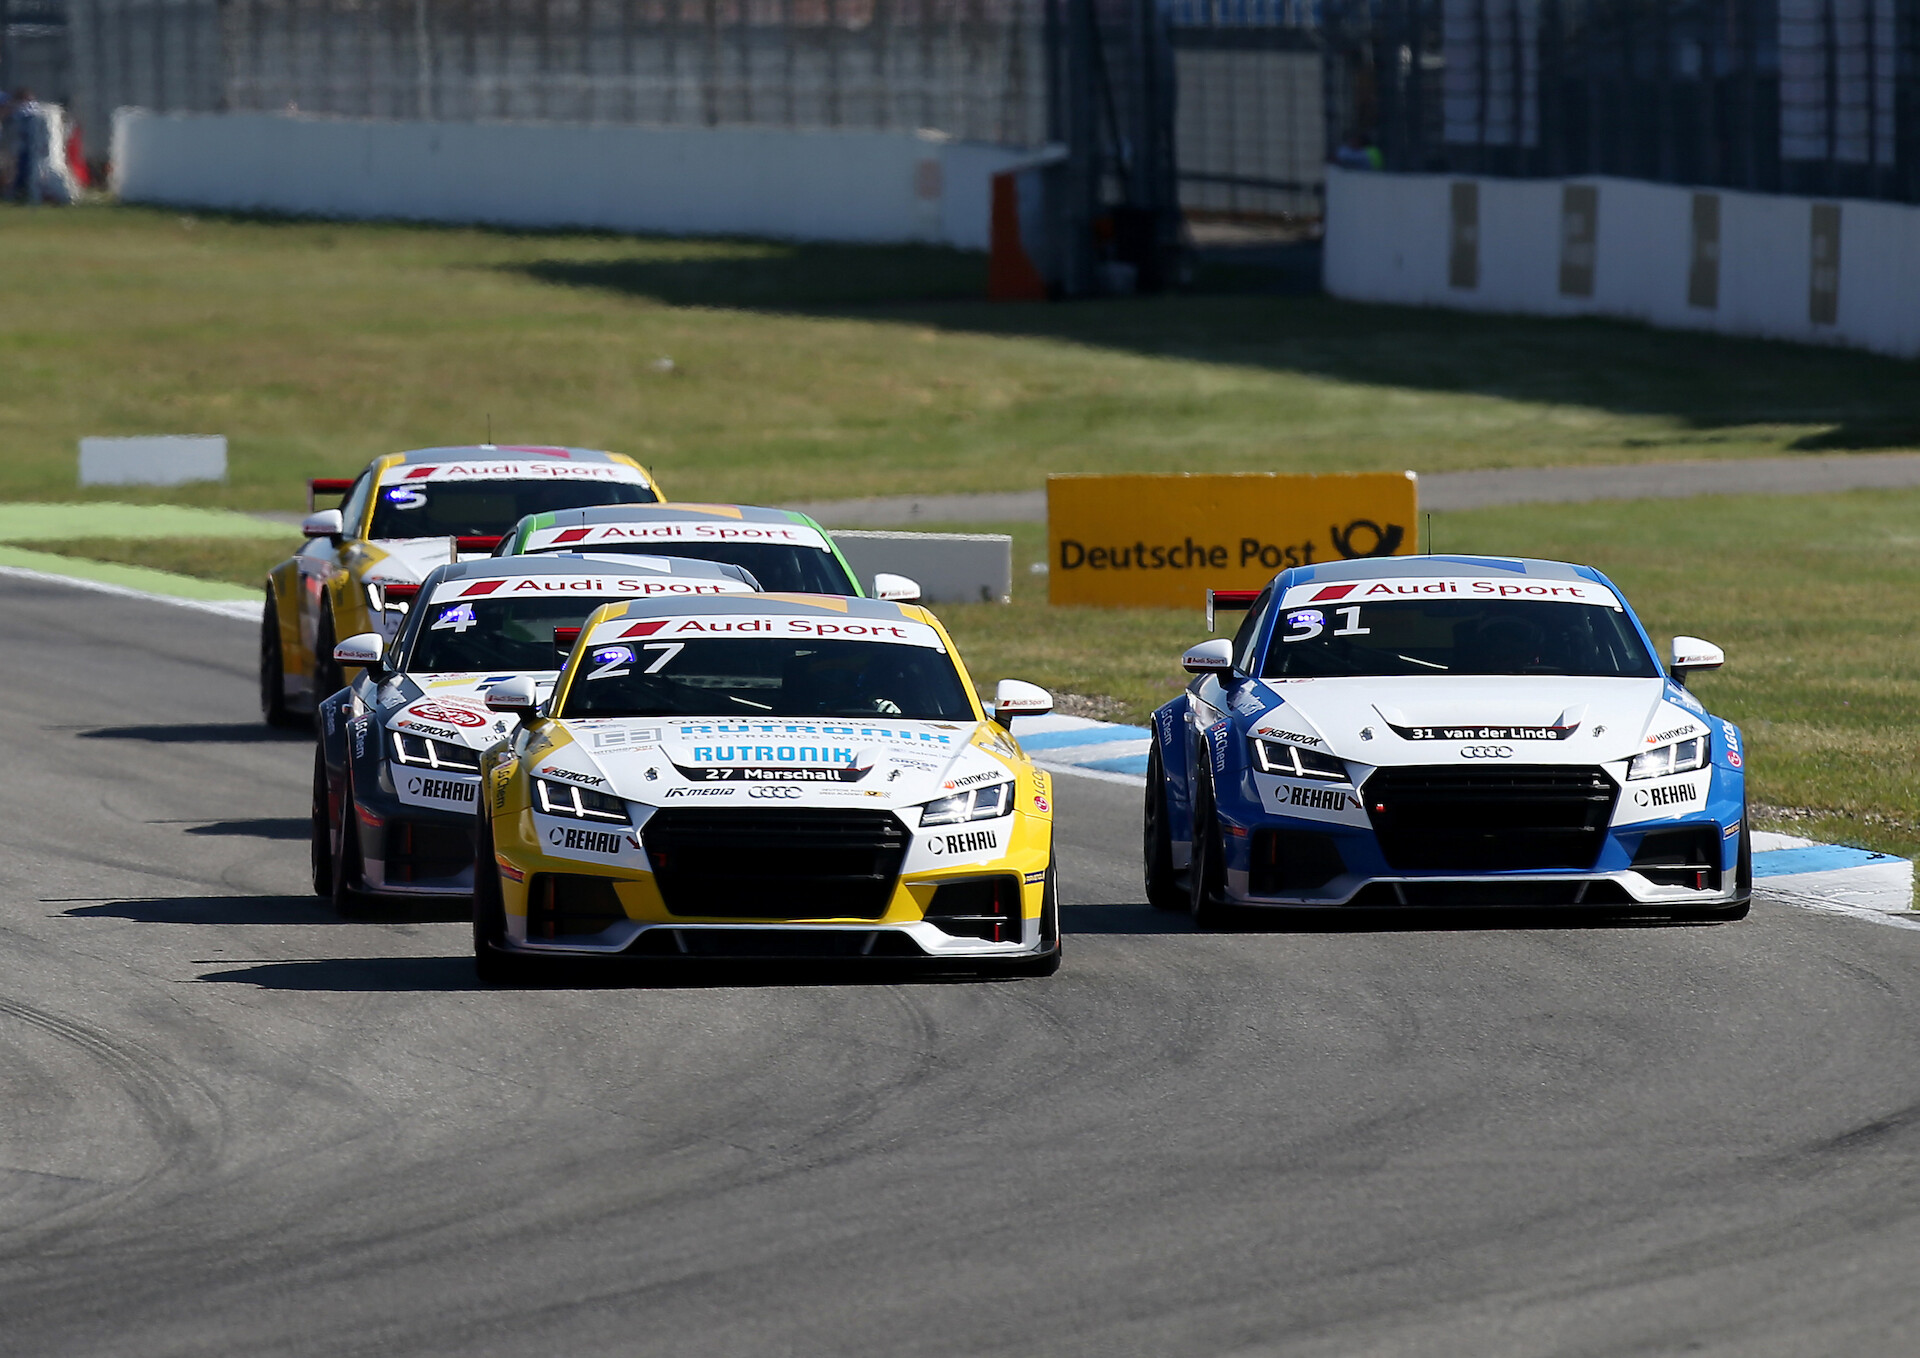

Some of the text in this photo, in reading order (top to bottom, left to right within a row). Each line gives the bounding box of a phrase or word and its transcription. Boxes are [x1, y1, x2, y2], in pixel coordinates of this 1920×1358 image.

[447, 464, 617, 479] Audi Sport
[395, 484, 428, 510] 5
[600, 526, 796, 540] Audi Sport
[1060, 537, 1317, 570] Deutsche Post
[512, 579, 726, 594] Audi Sport
[1365, 582, 1586, 598] Audi Sport
[430, 602, 477, 632] 4
[675, 620, 908, 638] Audi Sport
[1283, 606, 1370, 642] 31
[586, 643, 685, 681] 27
[1412, 728, 1557, 740] 31 van der Linde
[693, 746, 852, 763] RUTRONIK
[1216, 740, 1228, 773] Chem
[705, 769, 841, 780] 27 Marschall
[423, 778, 477, 802] REHAU
[1290, 787, 1346, 811] REHAU
[1651, 783, 1697, 806] REHAU
[565, 829, 621, 853] REHAU
[946, 830, 997, 854] REHAU
